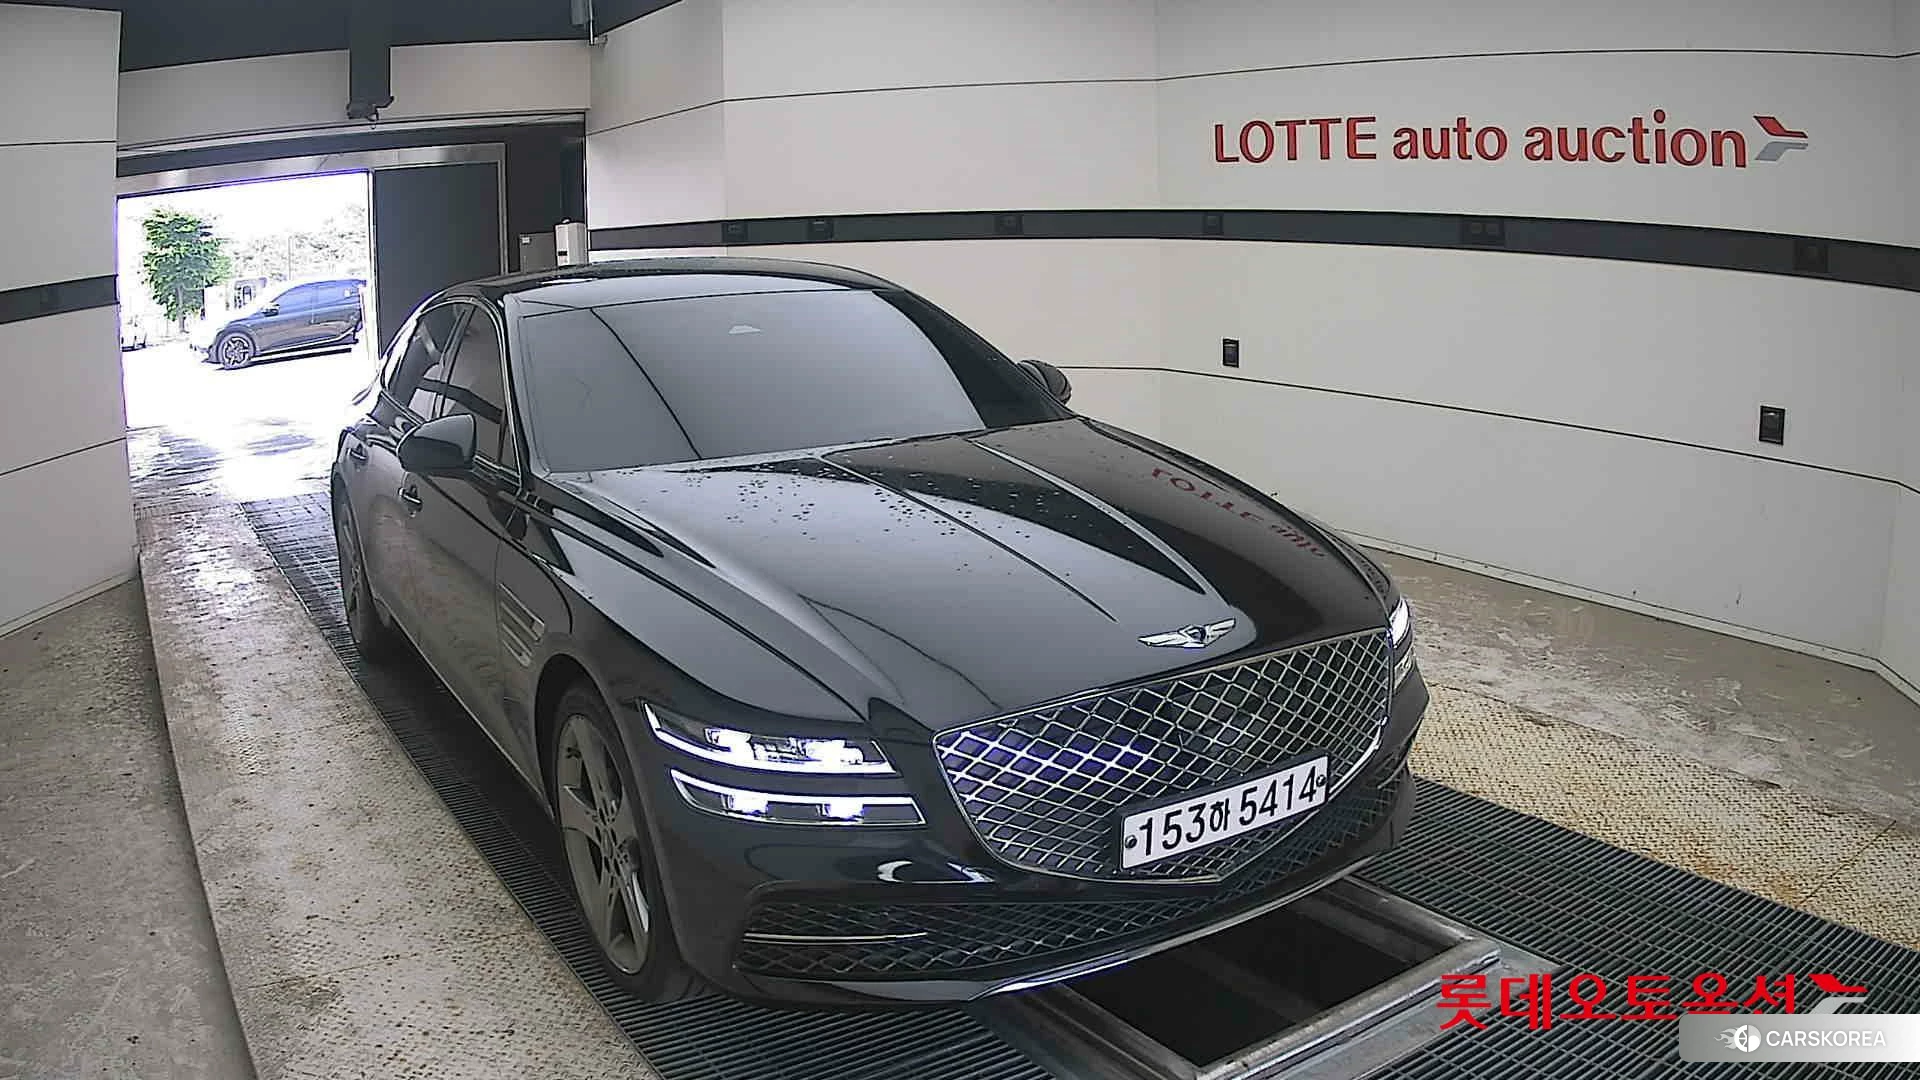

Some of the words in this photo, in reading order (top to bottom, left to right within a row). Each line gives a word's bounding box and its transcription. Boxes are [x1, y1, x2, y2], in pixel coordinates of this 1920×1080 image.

[1214, 115, 1377, 163] LOTTE
[1392, 116, 1509, 161] auto
[1523, 109, 1748, 168] auction
[1139, 797, 1231, 857] 153하
[1238, 765, 1317, 827] 5414
